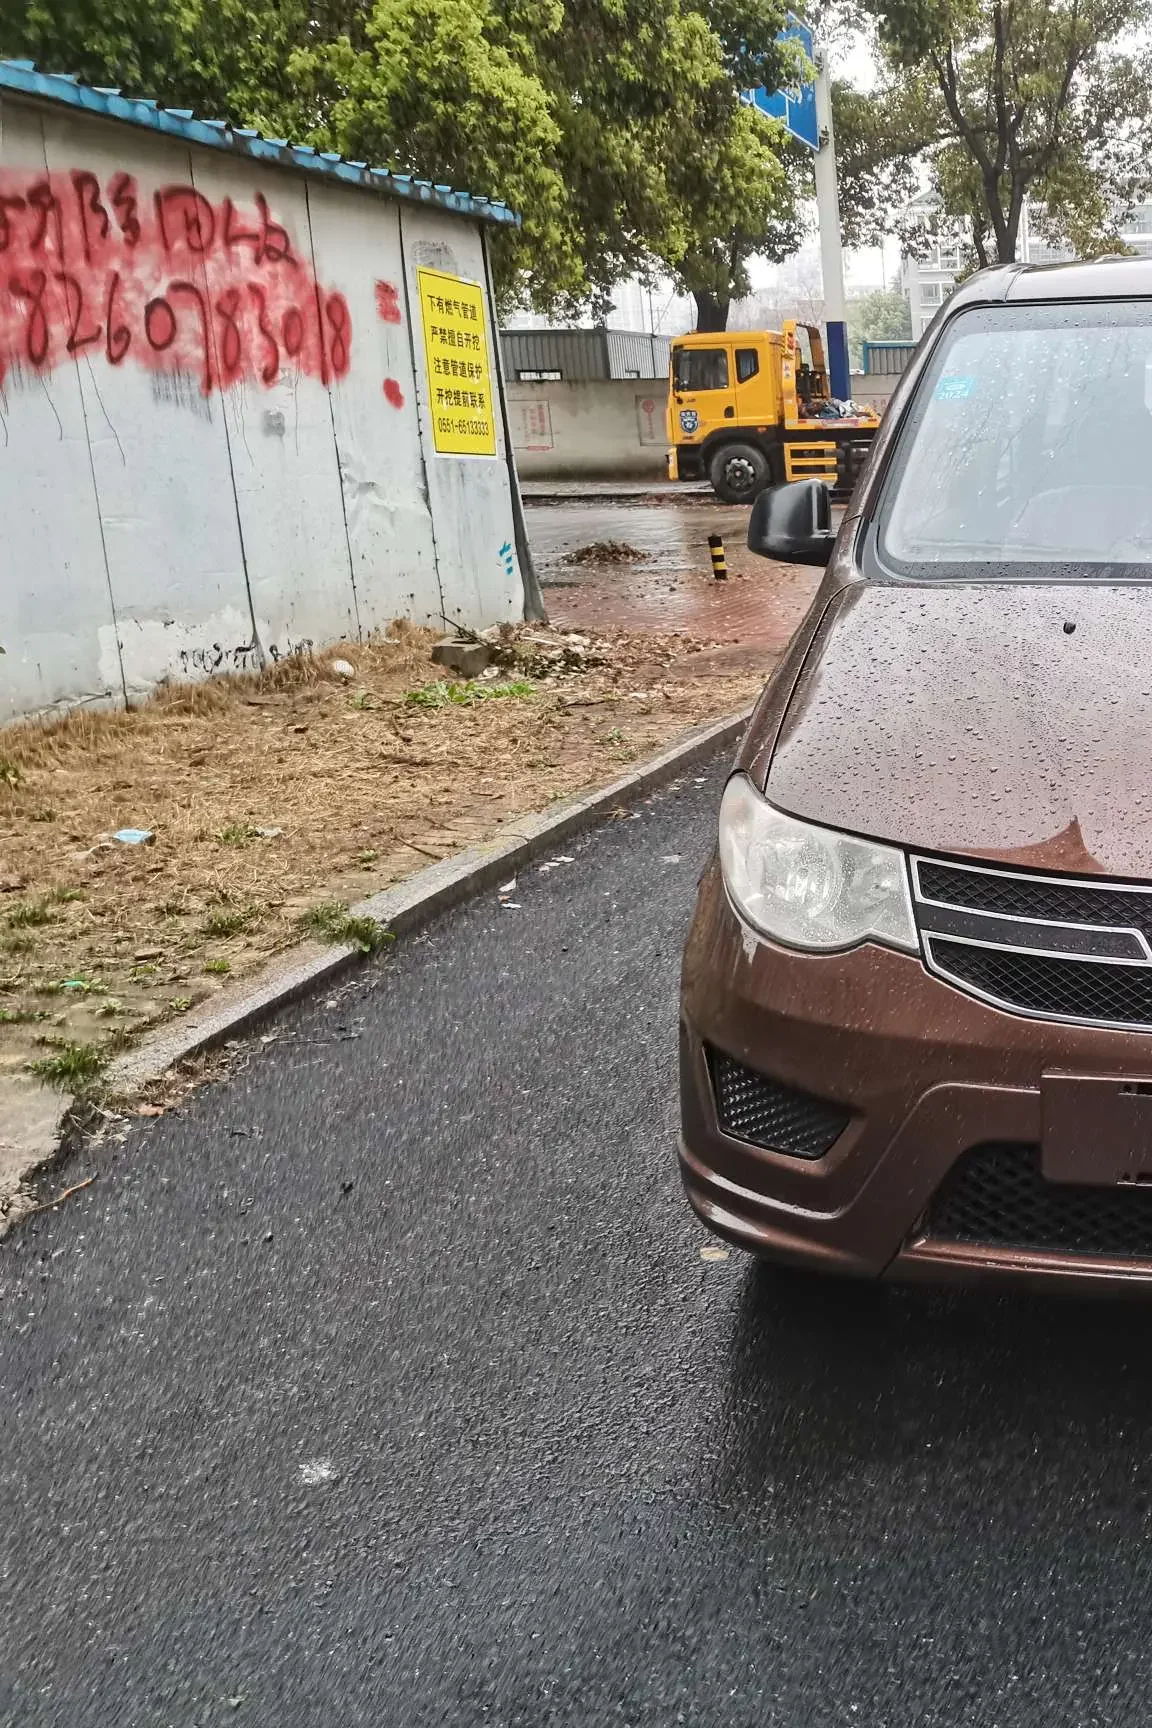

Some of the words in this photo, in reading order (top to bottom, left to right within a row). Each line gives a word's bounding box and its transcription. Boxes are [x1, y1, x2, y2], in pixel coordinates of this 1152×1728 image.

[427, 294, 478, 321] 下有燃气管道
[431, 325, 481, 351] 严禁擅自开挖
[434, 357, 483, 381] 注意管道保护
[436, 388, 486, 409] 开挖提前联系
